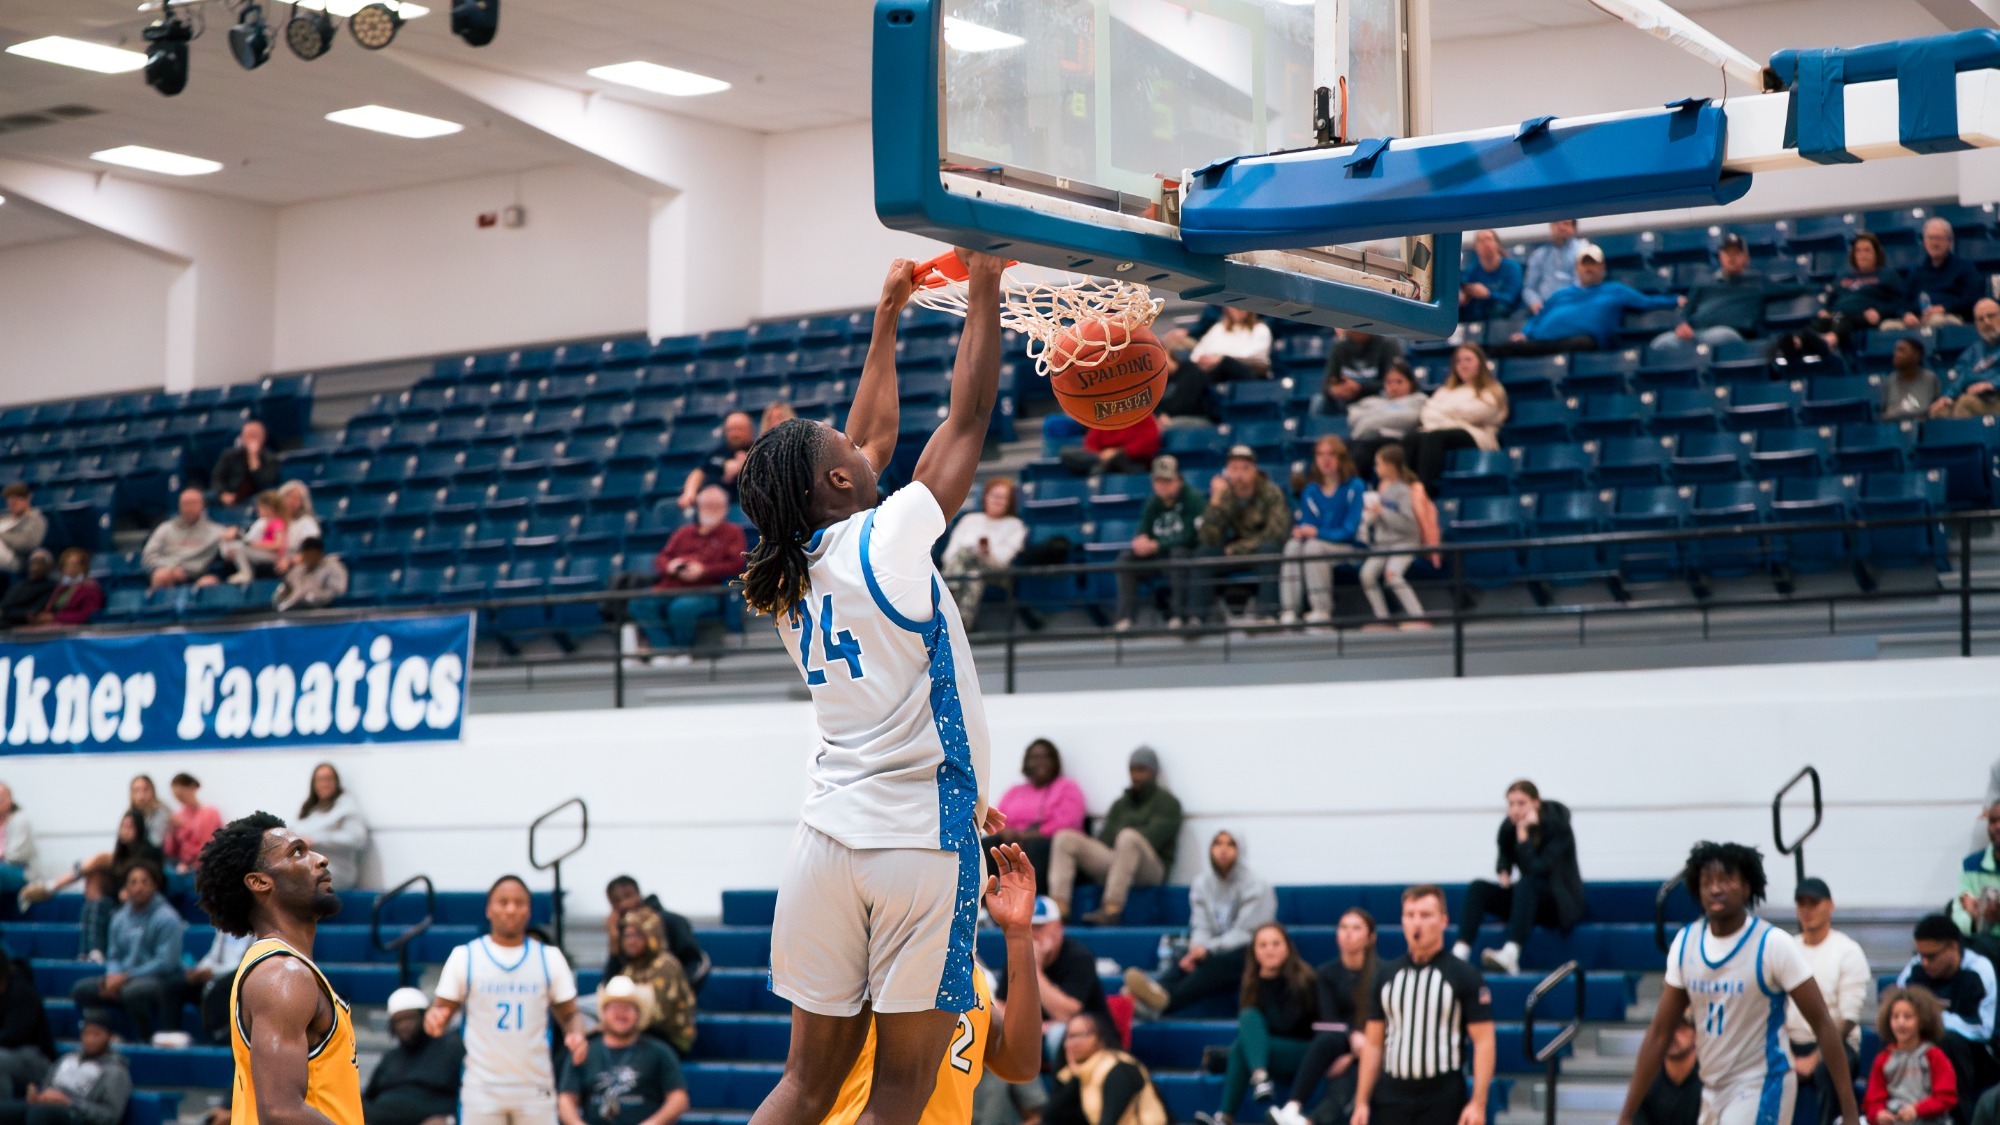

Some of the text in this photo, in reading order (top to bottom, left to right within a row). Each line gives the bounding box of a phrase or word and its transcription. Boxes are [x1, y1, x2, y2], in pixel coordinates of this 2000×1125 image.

[1077, 353, 1153, 390] SPALDING
[1094, 386, 1152, 420] NAIA
[787, 593, 864, 686] 24
[177, 635, 463, 740] Fanatics
[496, 1002, 524, 1030] 21
